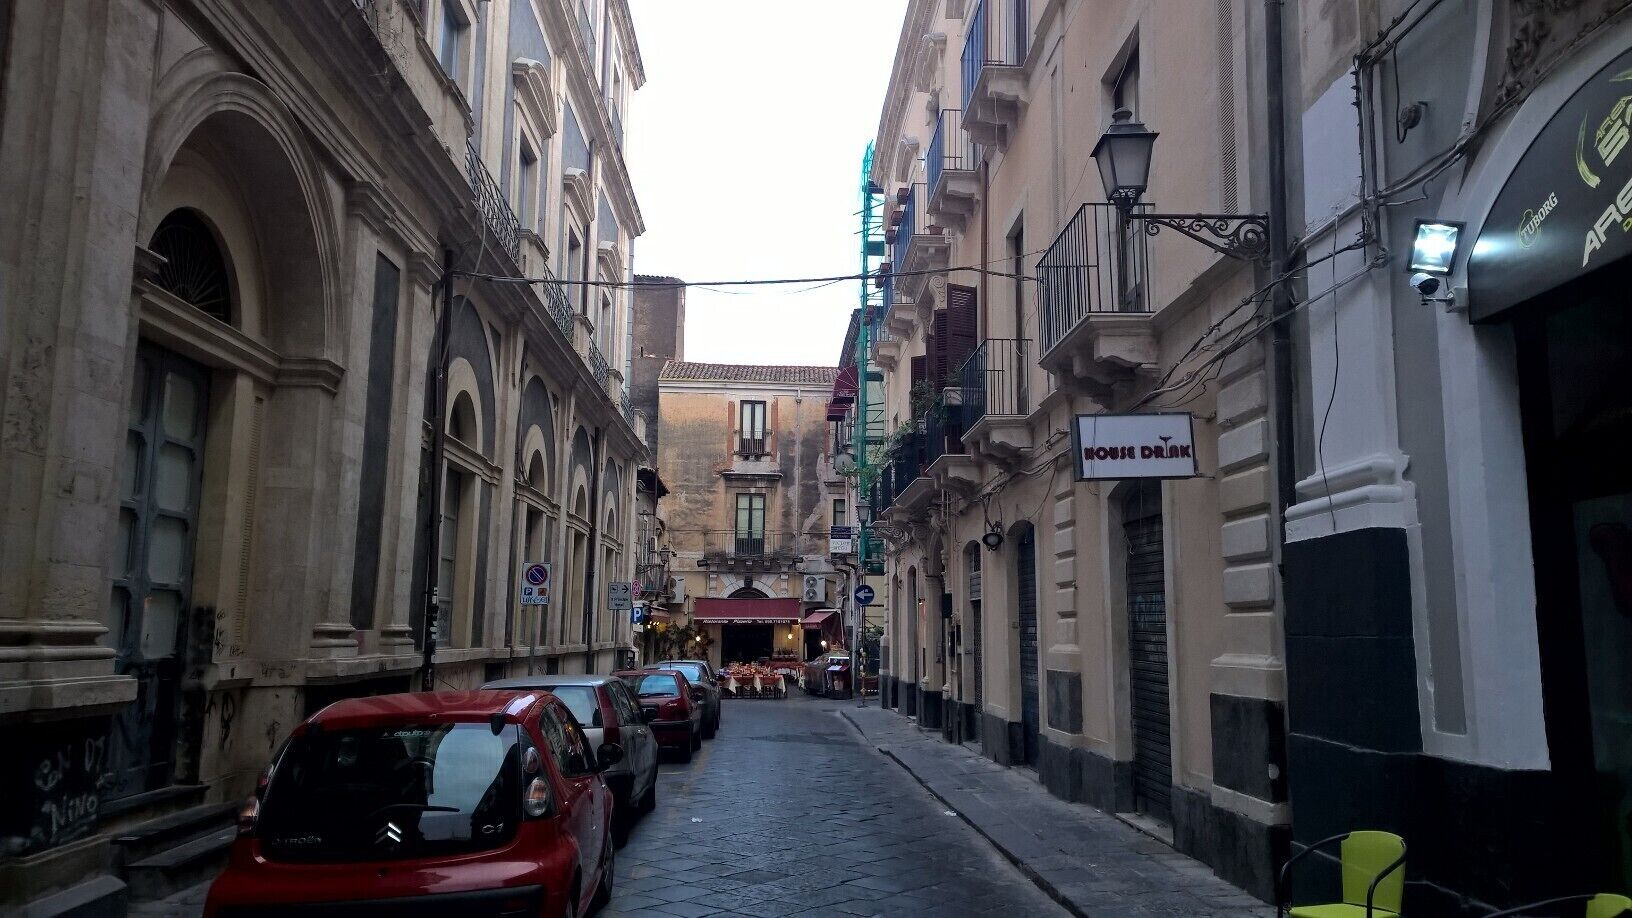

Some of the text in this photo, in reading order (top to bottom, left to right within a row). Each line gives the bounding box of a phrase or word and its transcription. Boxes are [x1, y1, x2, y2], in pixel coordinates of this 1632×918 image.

[1520, 191, 1559, 242] TUBORG
[1083, 436, 1192, 460] HOUSE DRINK
[633, 607, 642, 622] P
[481, 822, 504, 834] C1
